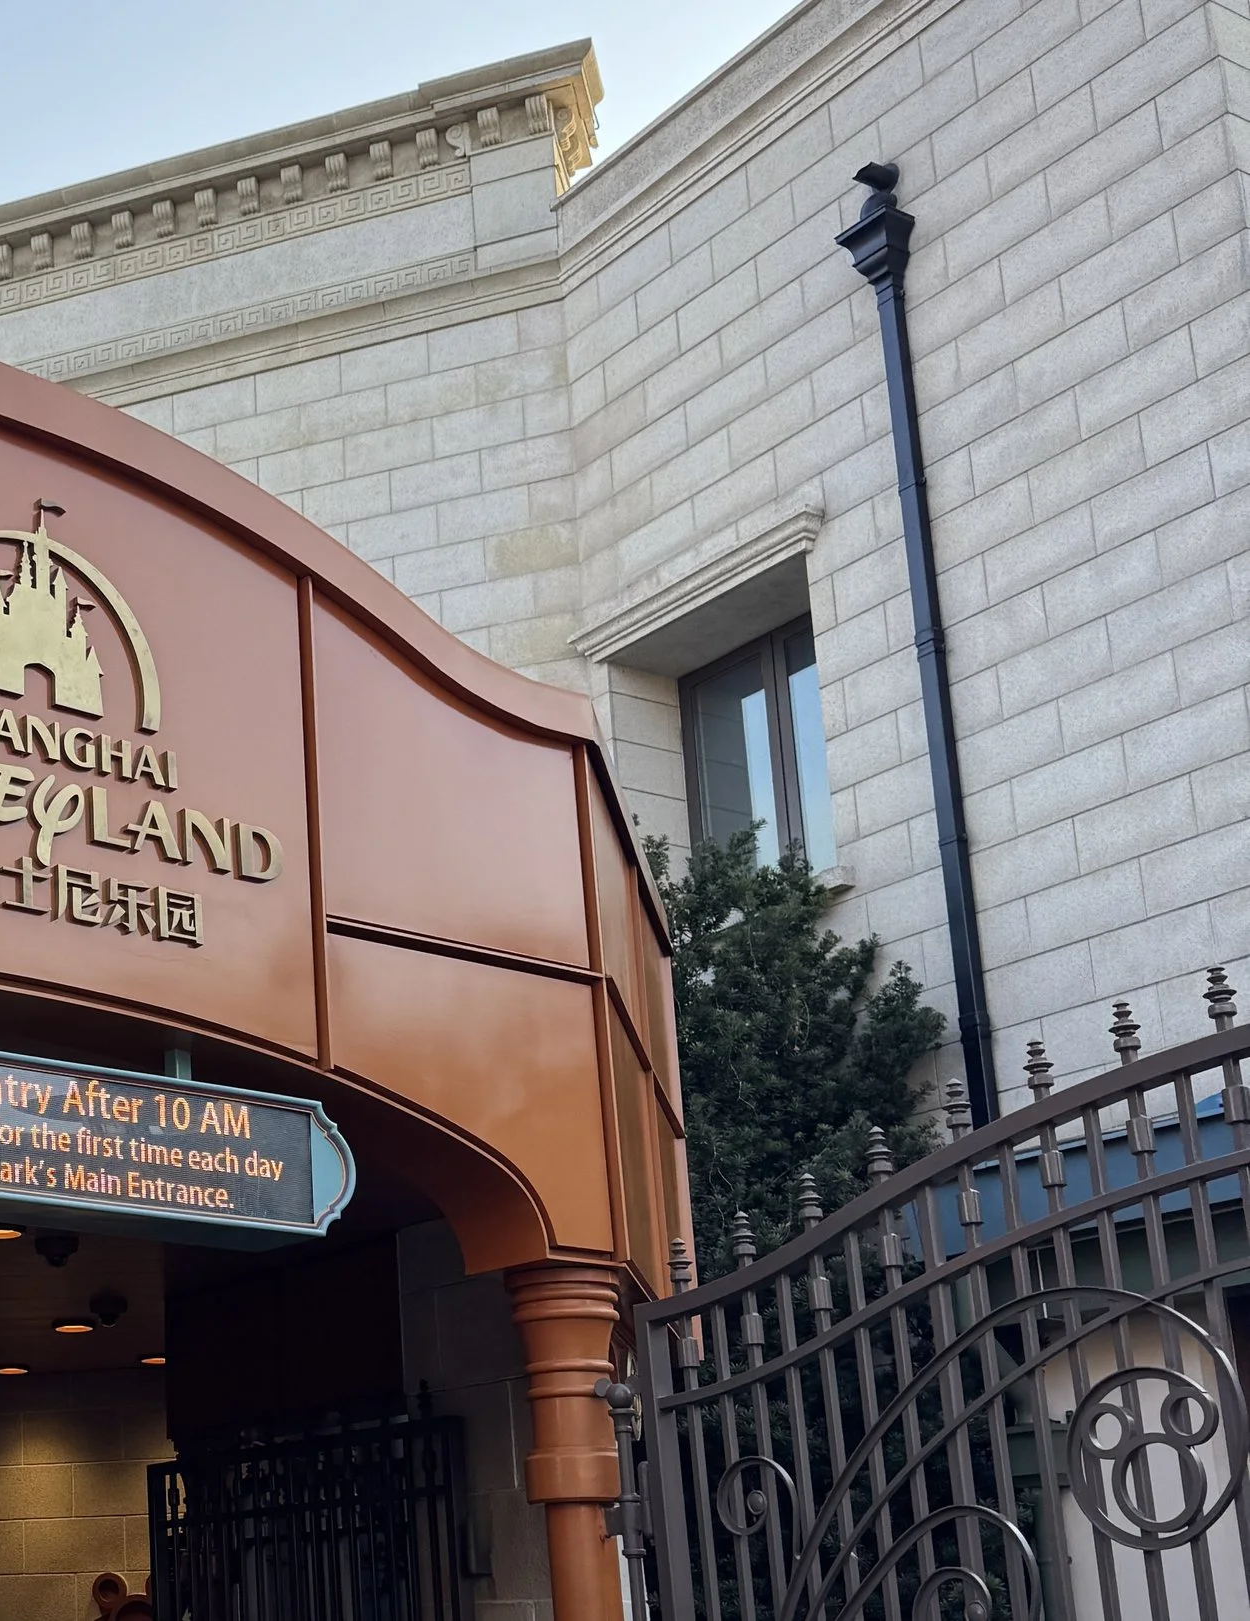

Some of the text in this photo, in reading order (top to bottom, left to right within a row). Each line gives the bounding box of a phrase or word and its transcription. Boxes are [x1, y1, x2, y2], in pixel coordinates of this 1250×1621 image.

[62, 1080, 144, 1125] After
[154, 1094, 191, 1131] 10
[200, 1102, 251, 1140] AM
[30, 1122, 71, 1153] the
[76, 1126, 124, 1160] first
[129, 1137, 183, 1168] time
[188, 1147, 240, 1175] each
[244, 1150, 285, 1182] day
[64, 1163, 122, 1197] Main
[127, 1171, 235, 1210] Entrance.
